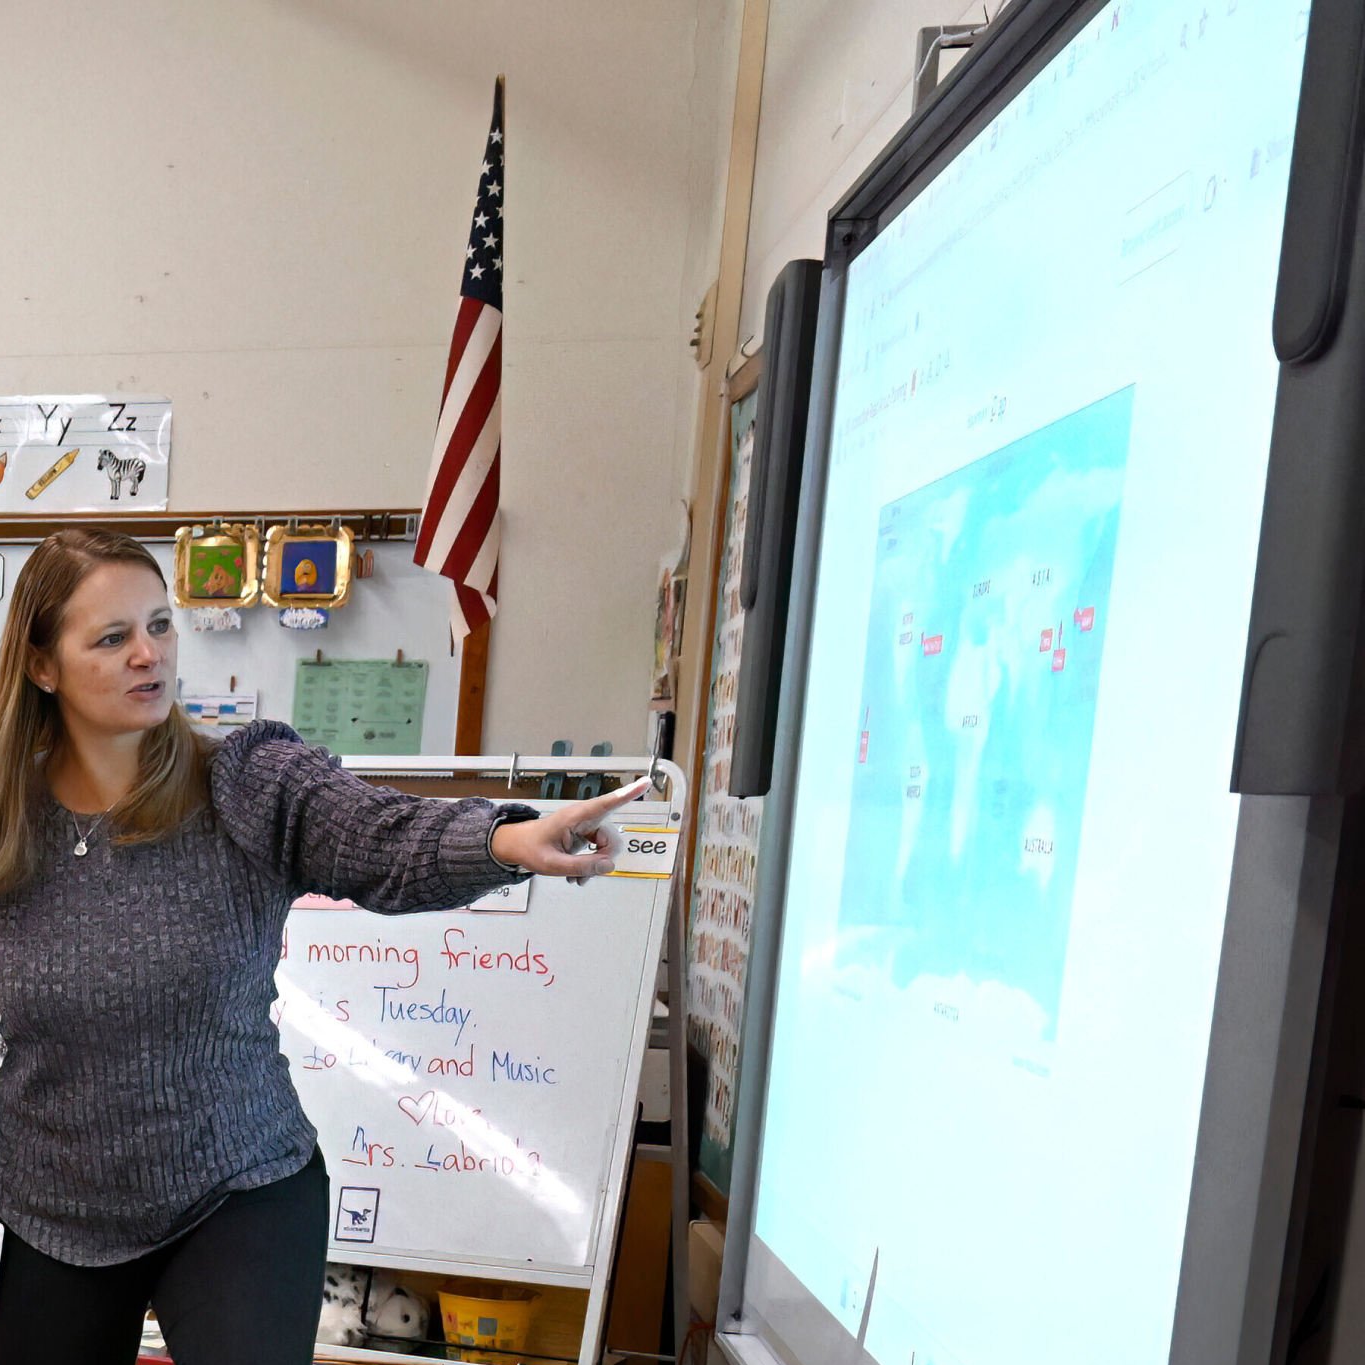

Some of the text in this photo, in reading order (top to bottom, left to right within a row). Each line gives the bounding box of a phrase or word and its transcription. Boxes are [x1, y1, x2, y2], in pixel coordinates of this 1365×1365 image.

[37, 403, 73, 447] Yy
[107, 402, 137, 432] Zz
[627, 838, 667, 855] see
[307, 938, 420, 989] morning
[440, 927, 555, 988] friends,
[373, 985, 478, 1047] Tuesday.
[427, 1043, 474, 1078] and
[490, 1050, 561, 1086] Music
